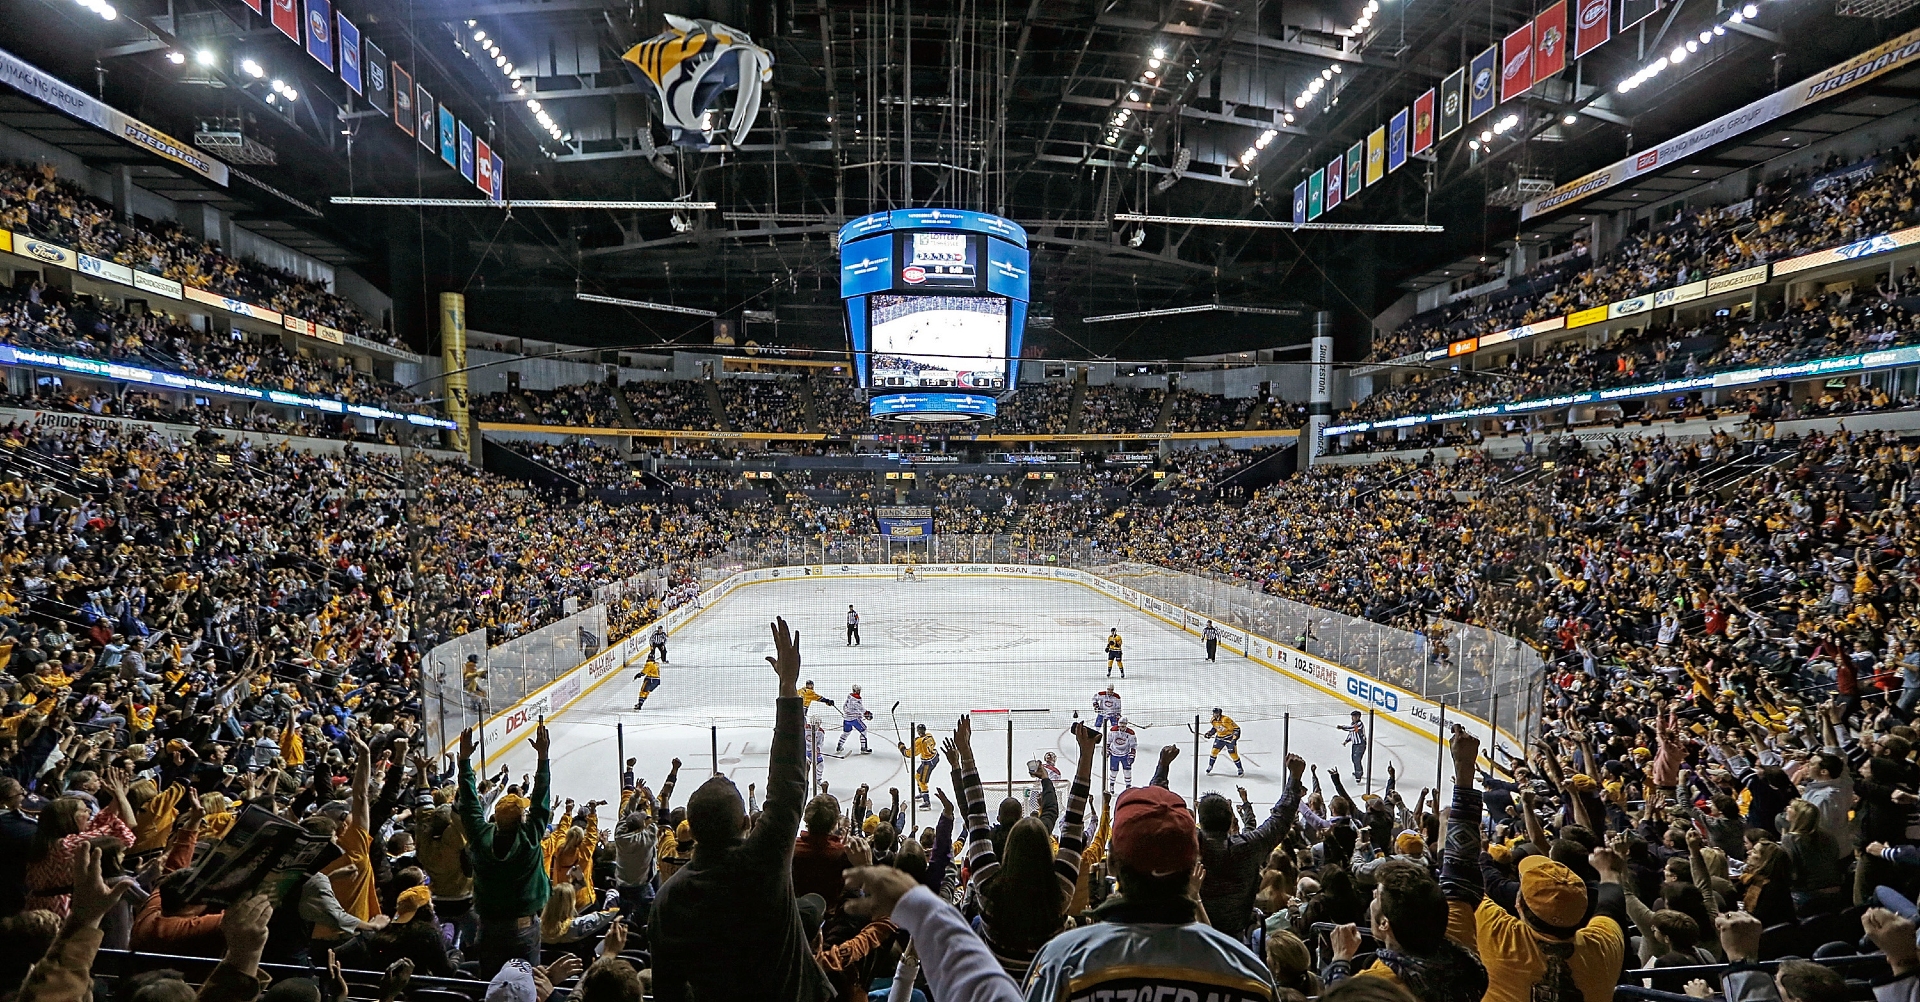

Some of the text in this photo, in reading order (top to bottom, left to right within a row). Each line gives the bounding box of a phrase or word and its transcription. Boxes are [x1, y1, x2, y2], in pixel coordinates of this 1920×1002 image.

[7, 63, 84, 108] IMAGING GROUP
[1659, 141, 1687, 160] BRAND
[1689, 124, 1725, 149] IMAGING
[1727, 108, 1761, 131] GROUP
[125, 123, 210, 173] PREDATORS
[1535, 173, 1611, 213] PREDATORS
[32, 242, 59, 260] Ford
[136, 275, 181, 295] BRIDGESTONE
[1710, 269, 1766, 292] BRIDGESTONE
[1620, 300, 1641, 313] Ford
[1318, 344, 1327, 395] BRIDGESTONE
[1773, 362, 1820, 376] University
[1820, 356, 1860, 370] Medical
[1861, 352, 1897, 364] Center
[994, 566, 1028, 574] NISSAN
[1295, 657, 1313, 674] 102.5
[1316, 664, 1338, 683] GAME
[1347, 676, 1398, 712] GEICO
[506, 707, 528, 735] DEX
[1411, 705, 1427, 720] Lids
